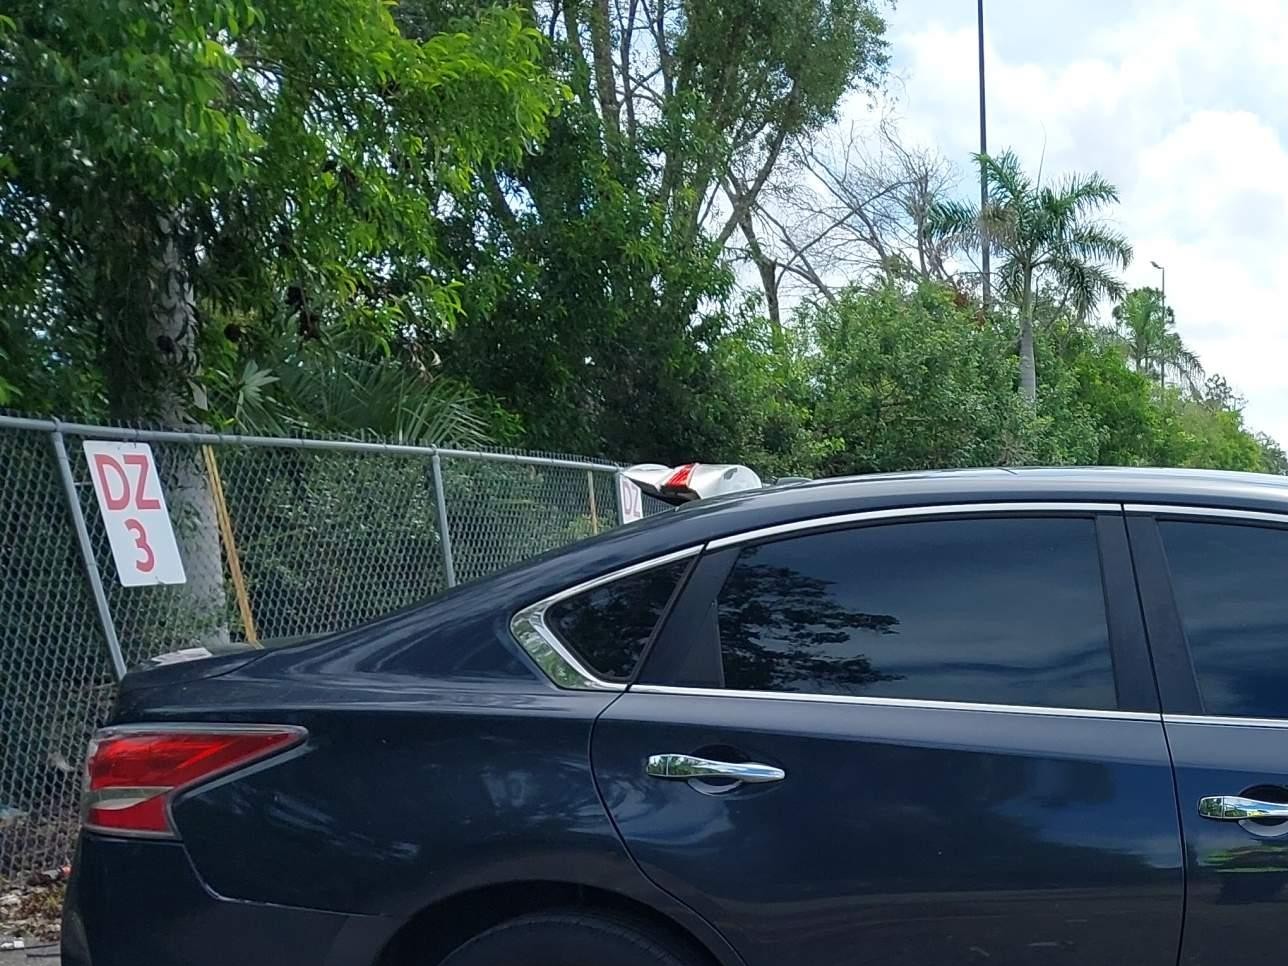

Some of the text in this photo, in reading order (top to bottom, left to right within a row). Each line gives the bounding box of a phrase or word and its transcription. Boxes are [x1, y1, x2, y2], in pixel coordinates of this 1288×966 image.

[94, 454, 161, 510] DZ
[623, 481, 641, 517] DZ
[124, 518, 155, 573] 3
